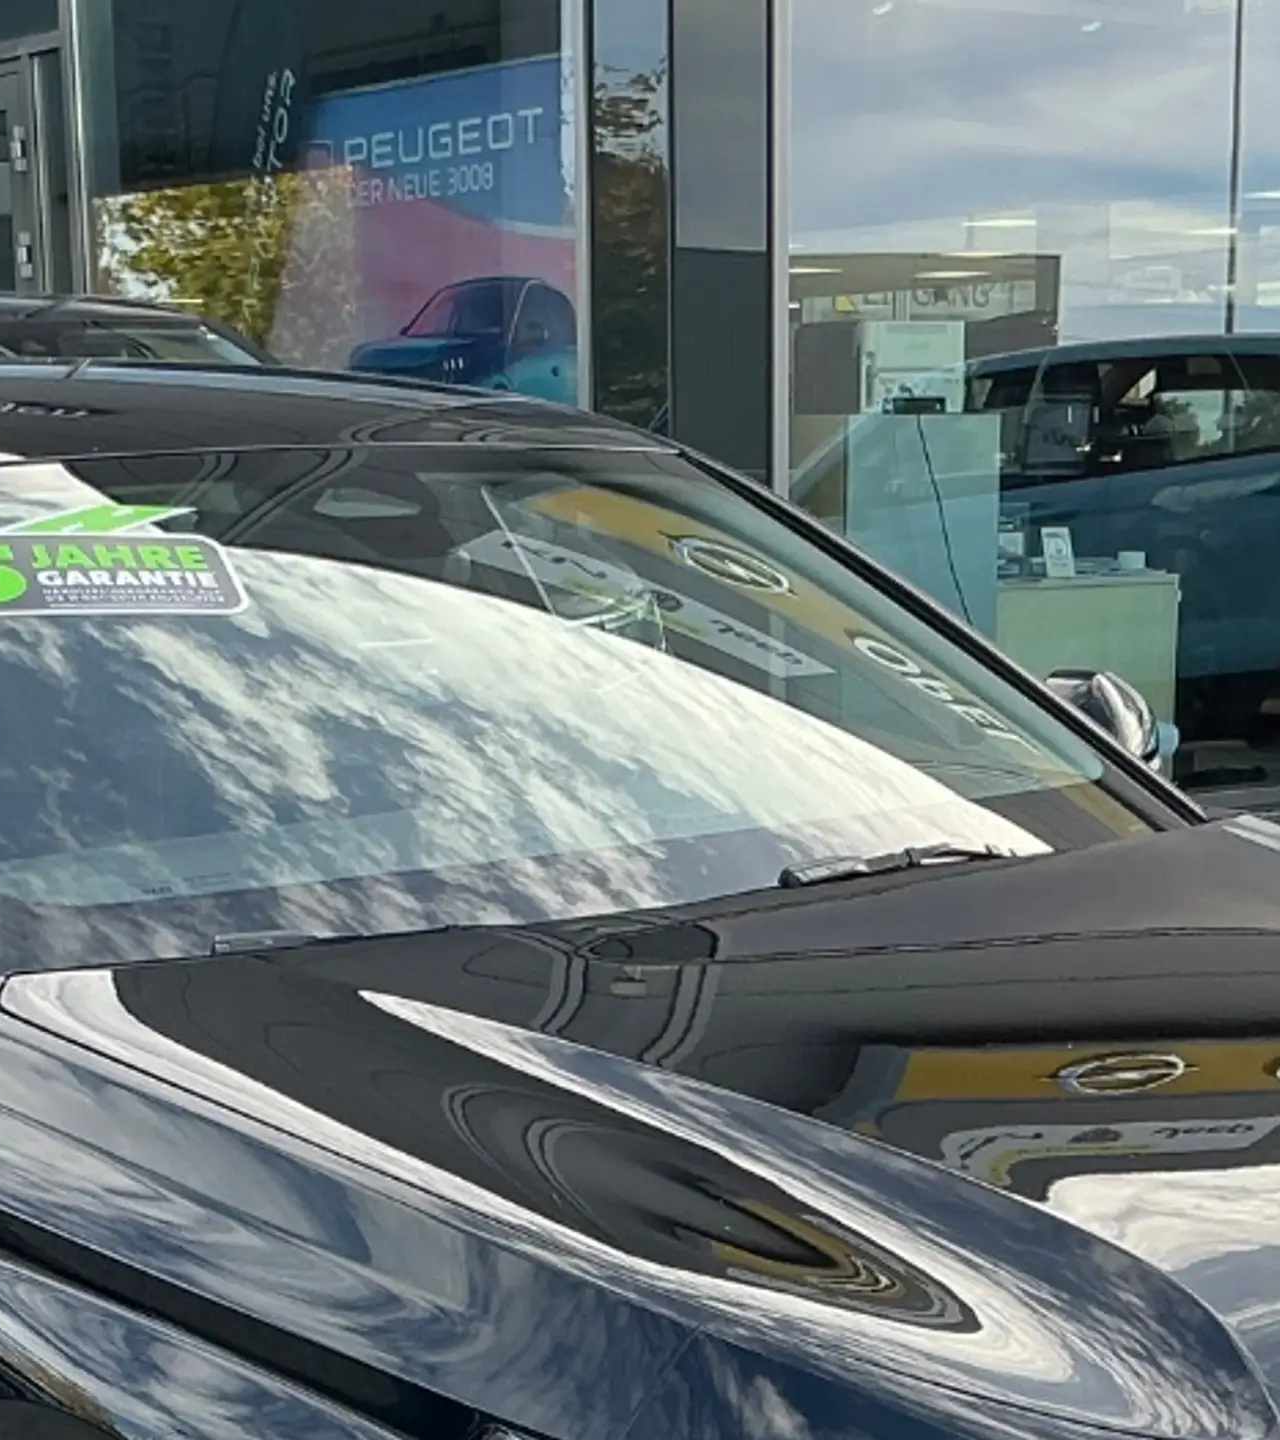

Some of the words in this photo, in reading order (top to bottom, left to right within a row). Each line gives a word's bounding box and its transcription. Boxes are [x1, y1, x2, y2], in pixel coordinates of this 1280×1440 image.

[343, 106, 544, 170] PEUGEOT
[386, 167, 442, 205] NEUE
[446, 161, 495, 198] 3008
[31, 543, 210, 570] JAHRE
[36, 570, 220, 590] GARANTIE
